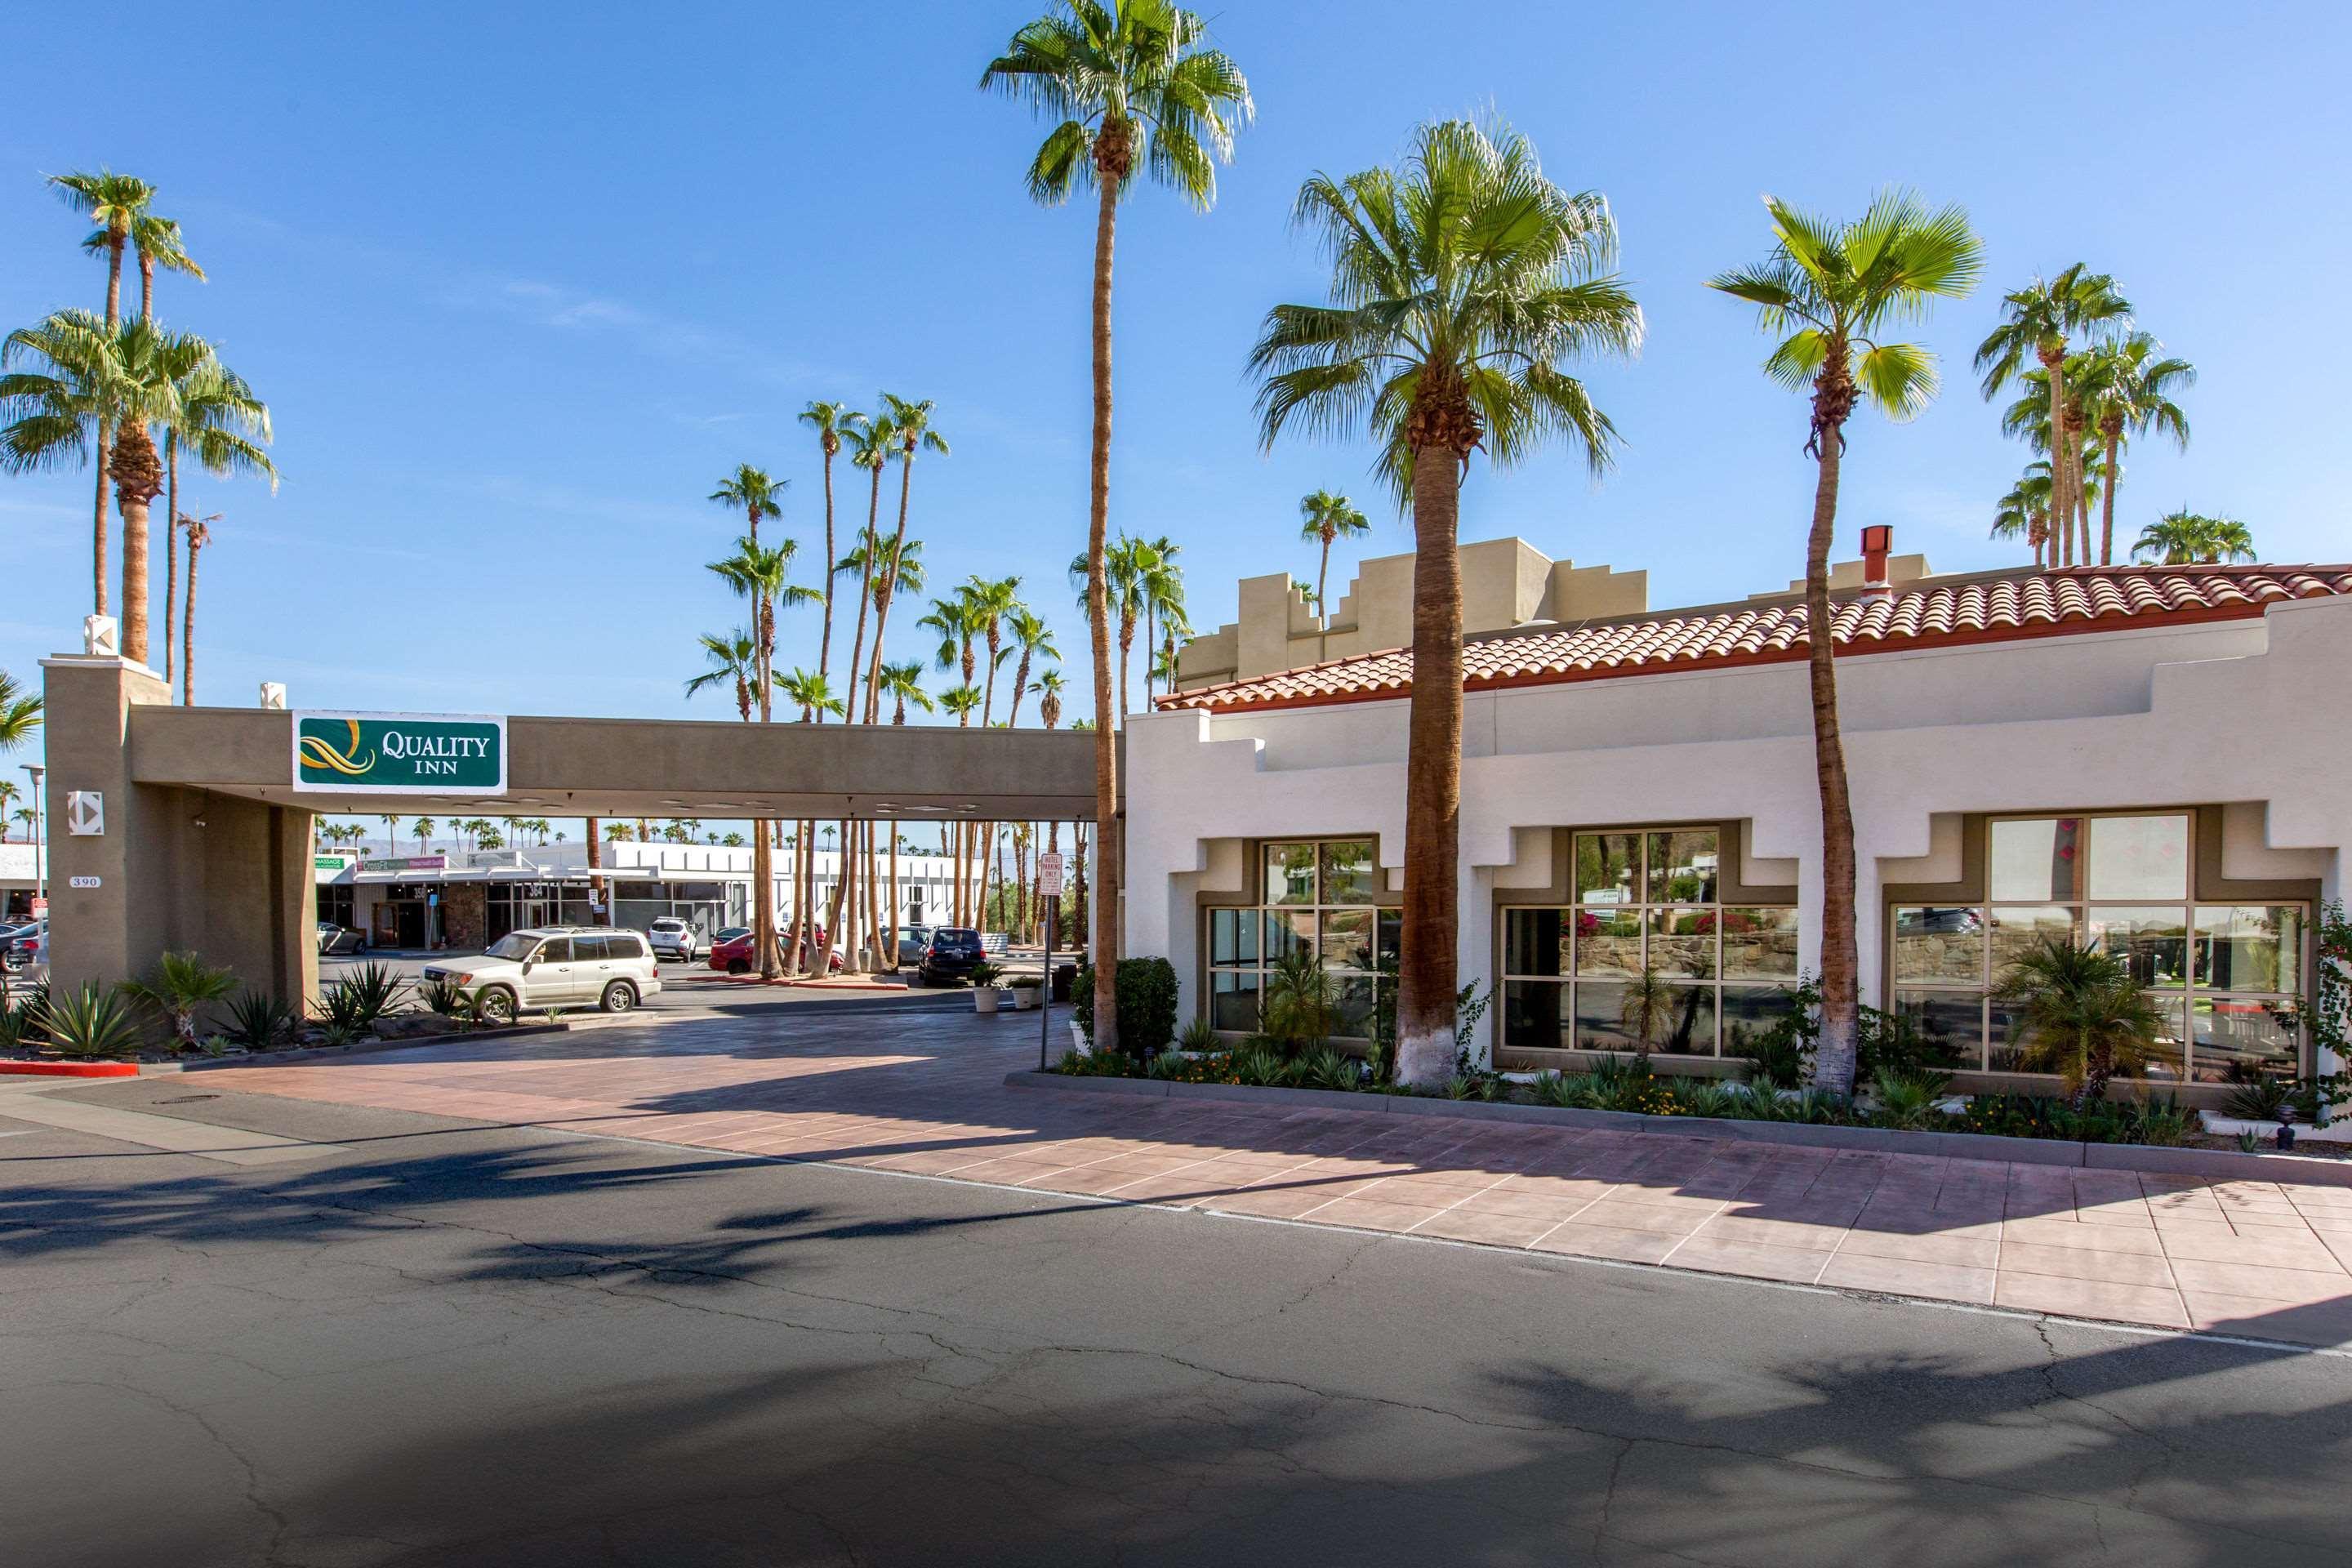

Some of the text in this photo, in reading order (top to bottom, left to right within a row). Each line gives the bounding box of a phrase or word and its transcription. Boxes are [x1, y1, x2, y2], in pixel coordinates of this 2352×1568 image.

[382, 731, 490, 759] QUALITY
[415, 760, 457, 774] INN
[363, 860, 388, 871] CrossFit
[74, 878, 97, 886] 390
